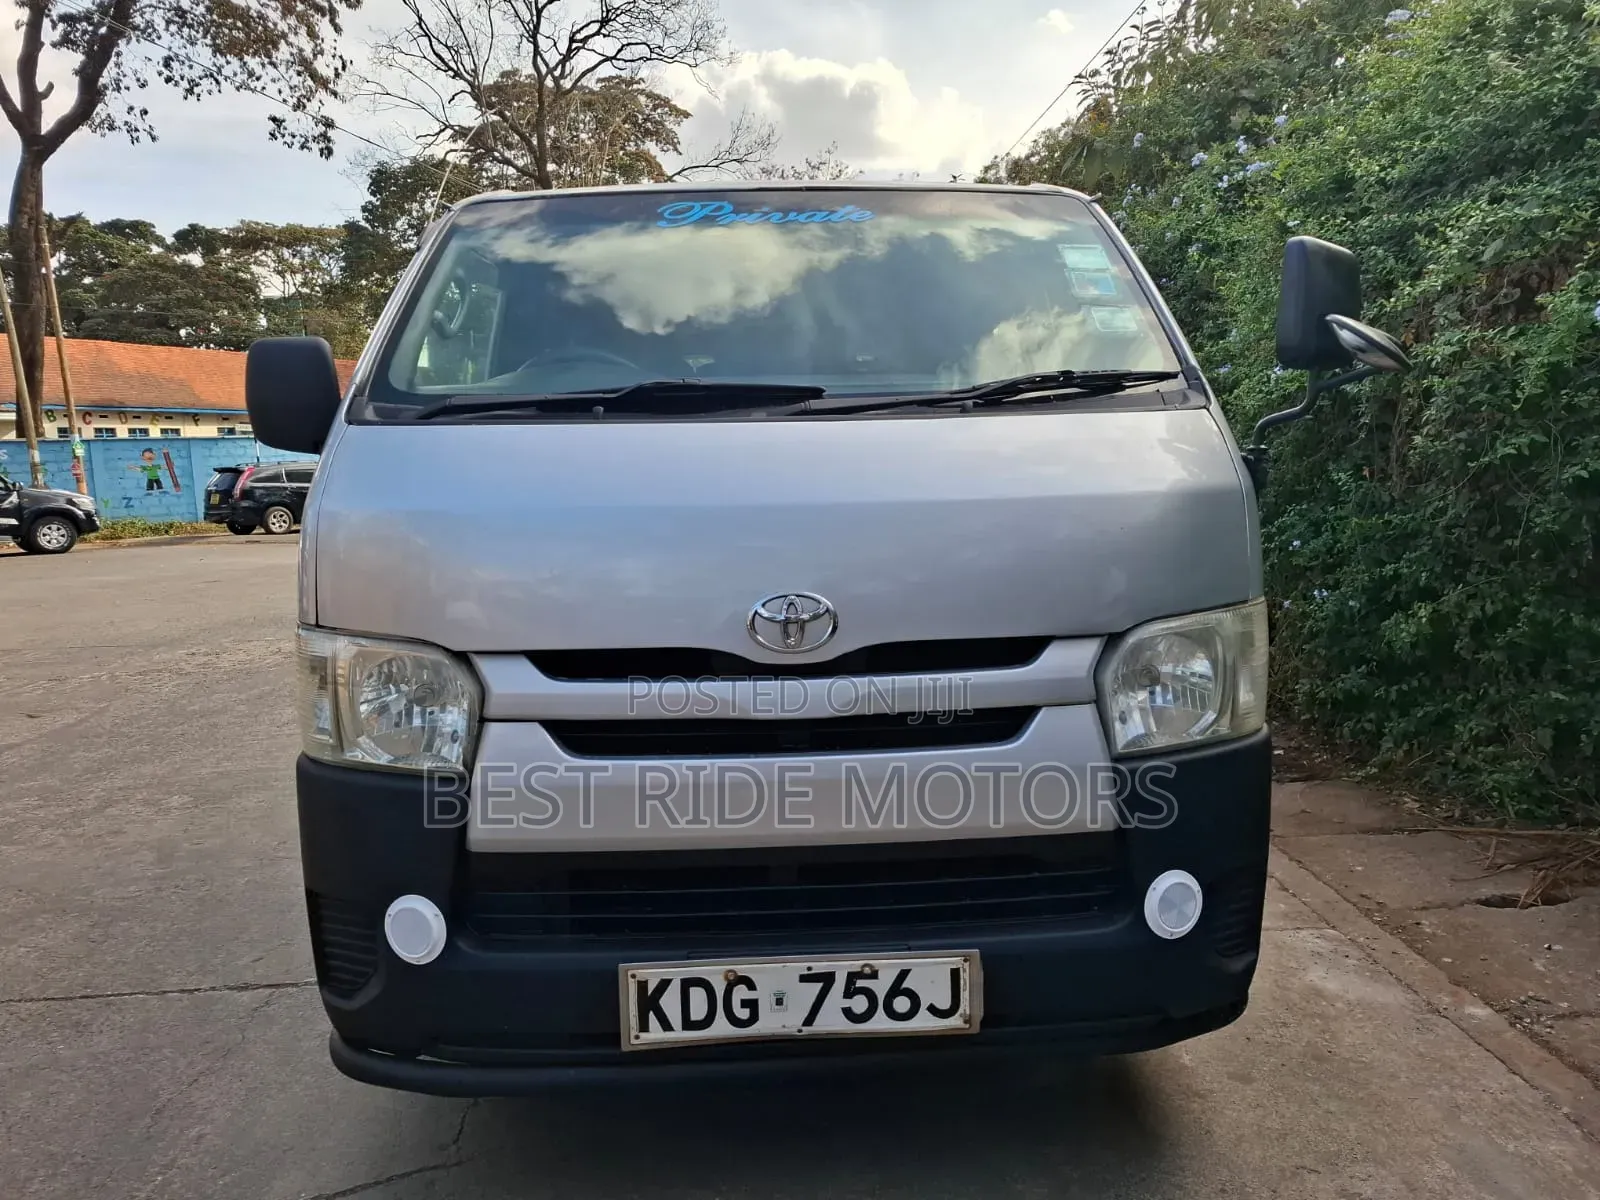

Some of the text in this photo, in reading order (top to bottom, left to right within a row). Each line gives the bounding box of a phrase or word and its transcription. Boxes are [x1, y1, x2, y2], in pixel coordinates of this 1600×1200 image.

[656, 200, 877, 228] Private
[45, 409, 57, 423] B
[82, 411, 93, 425] C
[118, 411, 129, 425] D
[122, 496, 134, 508] Z
[636, 967, 962, 1033] KDG 756J
